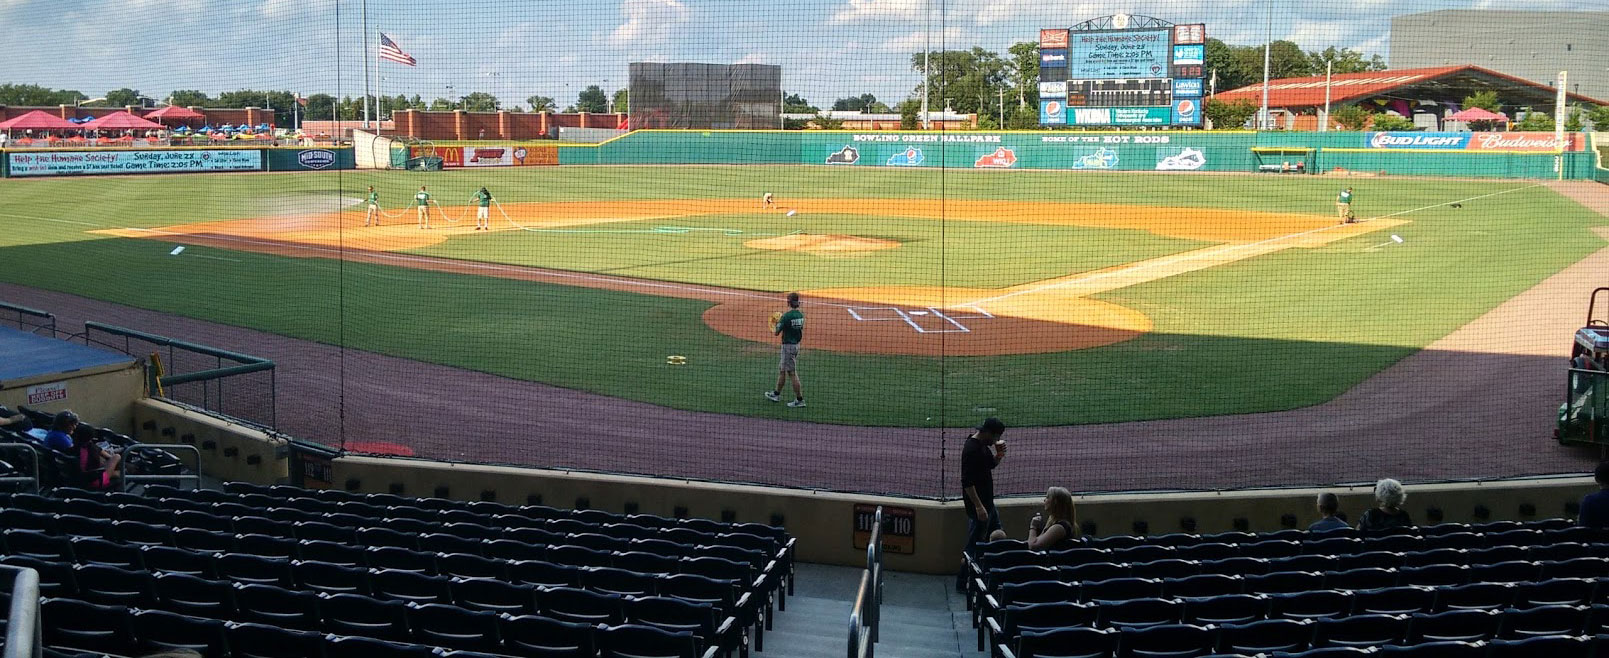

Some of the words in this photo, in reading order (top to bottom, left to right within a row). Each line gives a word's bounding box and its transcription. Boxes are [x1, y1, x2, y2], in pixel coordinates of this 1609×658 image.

[1082, 36, 1094, 44] Help
[1134, 34, 1160, 42] Society!
[1141, 50, 1153, 58] PM
[941, 135, 1002, 143] BALLPARK
[1103, 135, 1131, 143] HOT
[1134, 135, 1171, 143] RODS
[1378, 136, 1412, 145] BUD
[1413, 137, 1464, 146] LIGHT
[14, 155, 32, 164] Help
[35, 154, 50, 164] the
[51, 154, 84, 163] Humane
[85, 152, 119, 162] Society!
[134, 152, 164, 161] Sunday,
[165, 151, 183, 160] June
[126, 161, 148, 170] Game
[149, 160, 170, 169] Time:
[171, 160, 189, 169] 2:05
[190, 159, 203, 168] PM
[894, 516, 911, 535] 110
